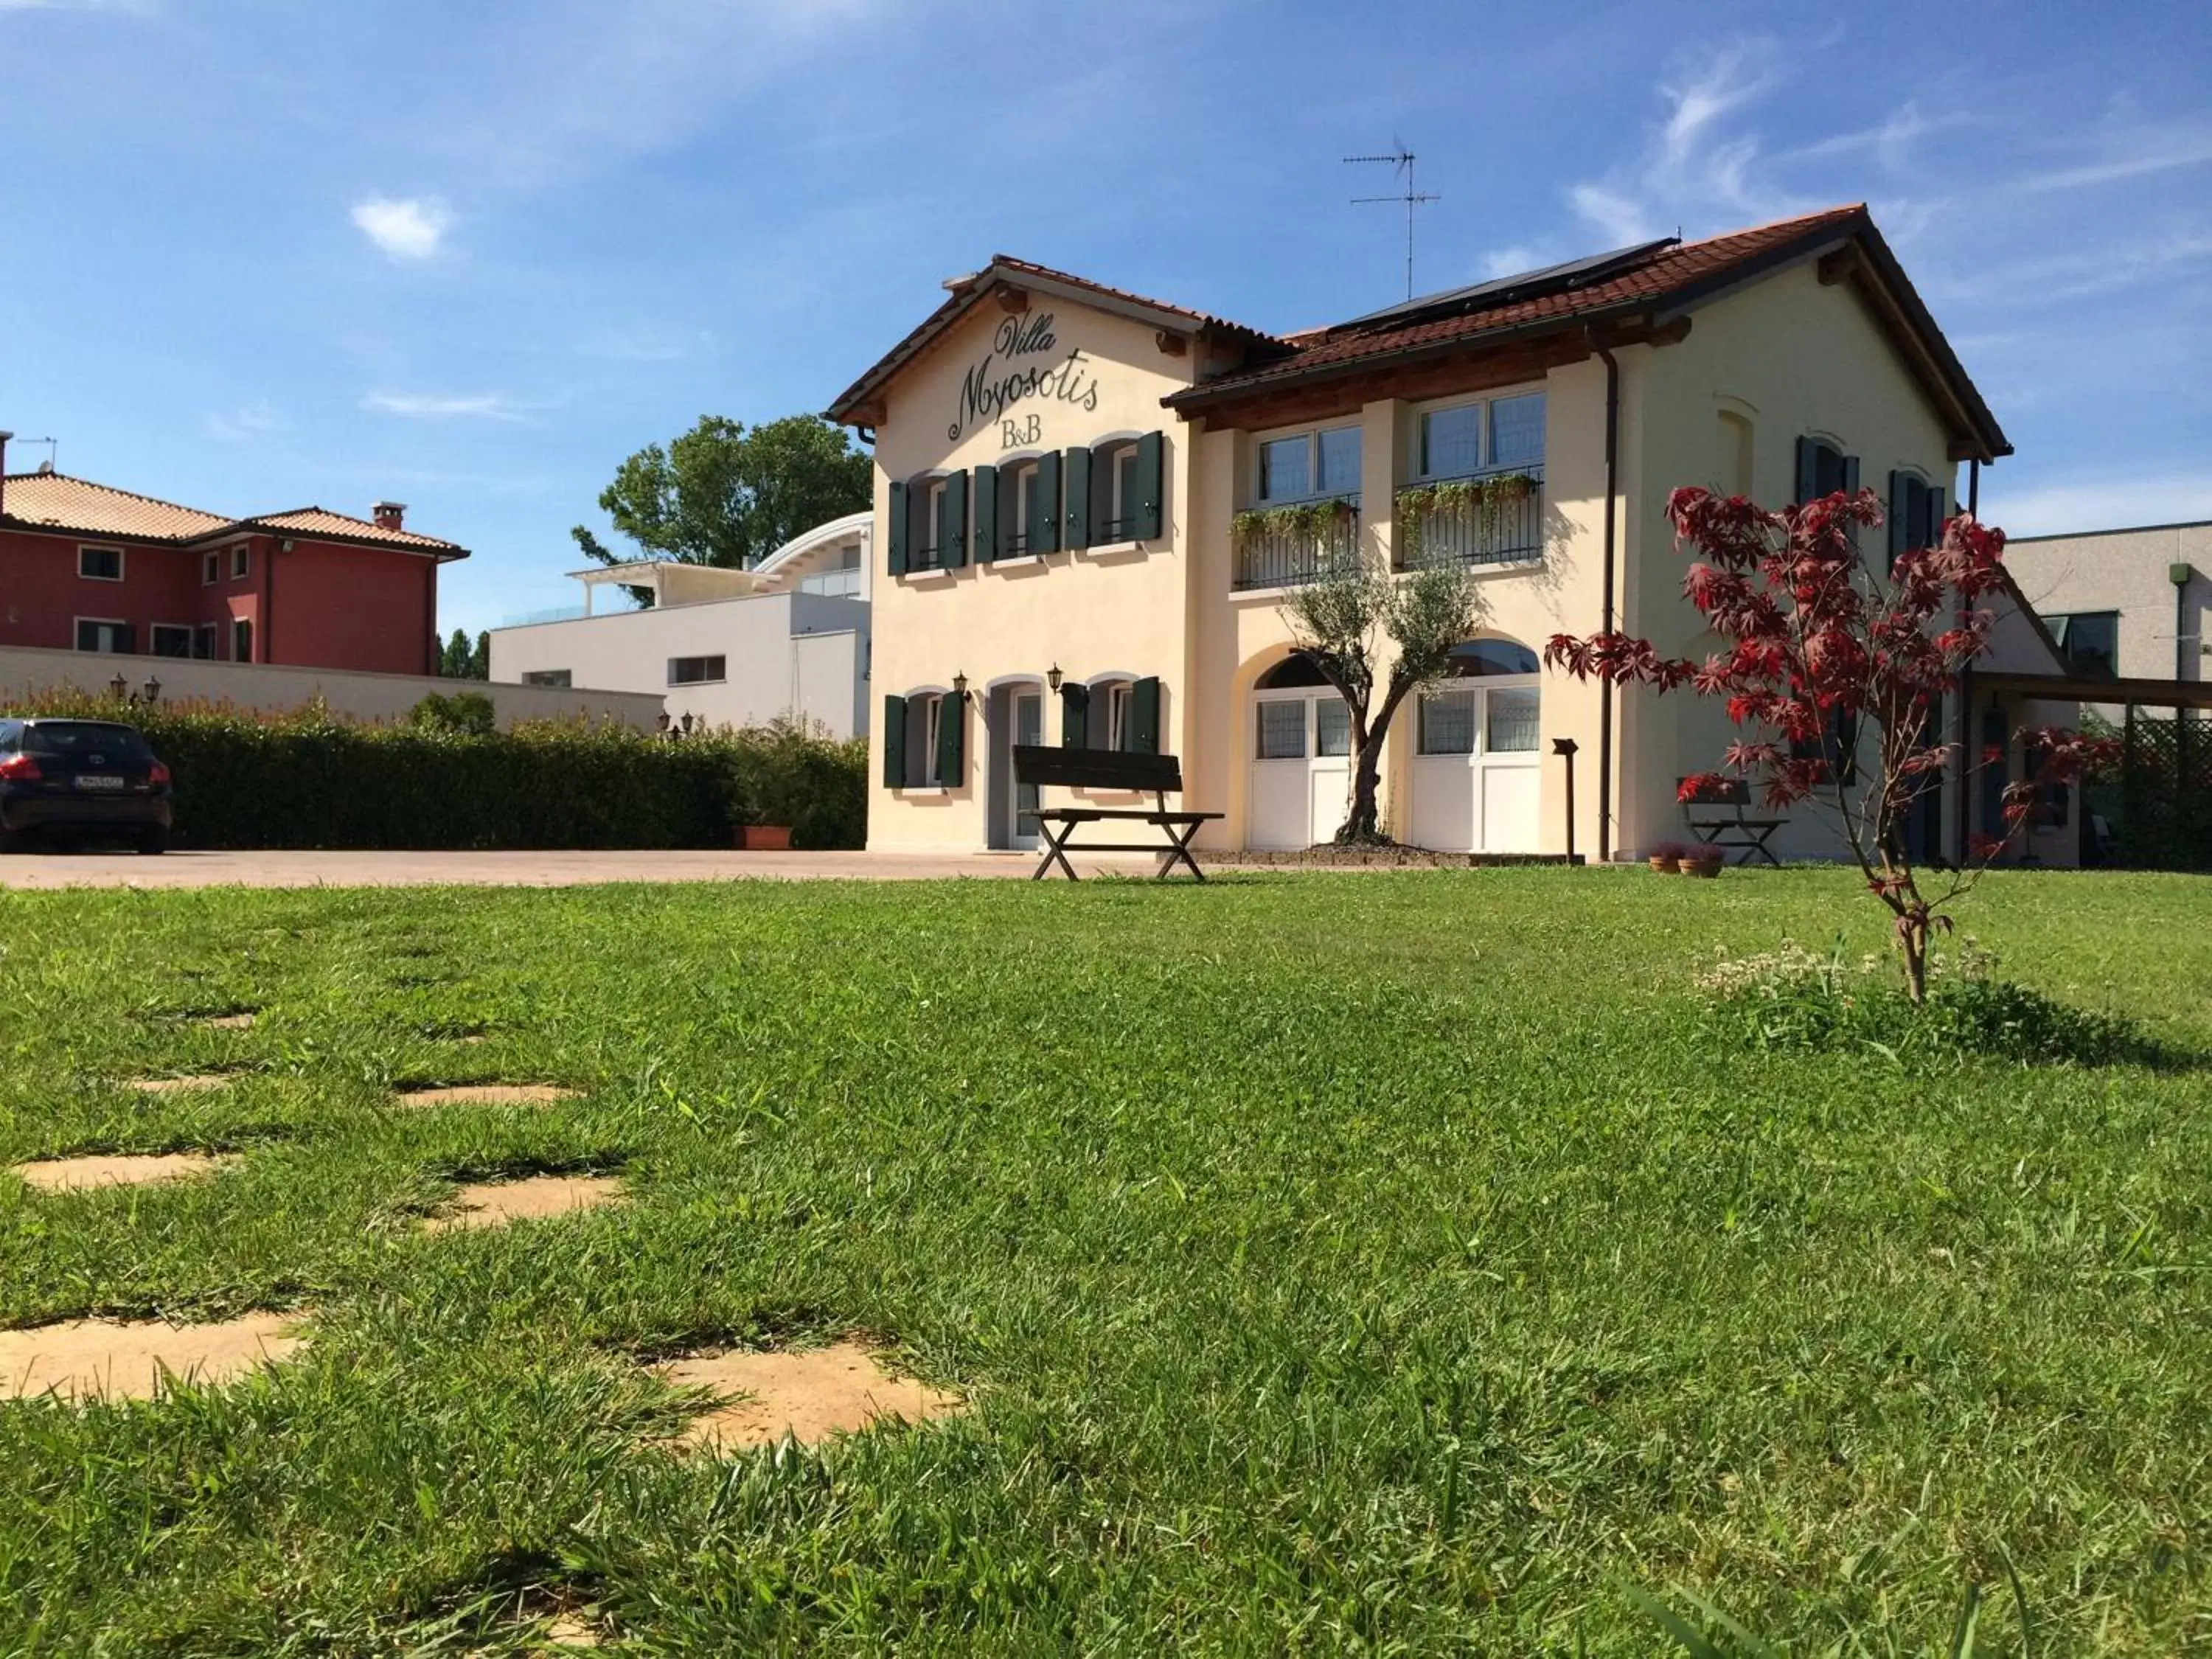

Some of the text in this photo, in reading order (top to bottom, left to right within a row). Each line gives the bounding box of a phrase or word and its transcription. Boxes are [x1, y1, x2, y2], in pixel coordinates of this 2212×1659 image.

[995, 307, 1057, 360] Villa
[948, 348, 1098, 440] Myosotis
[1001, 413, 1042, 449] B&B
